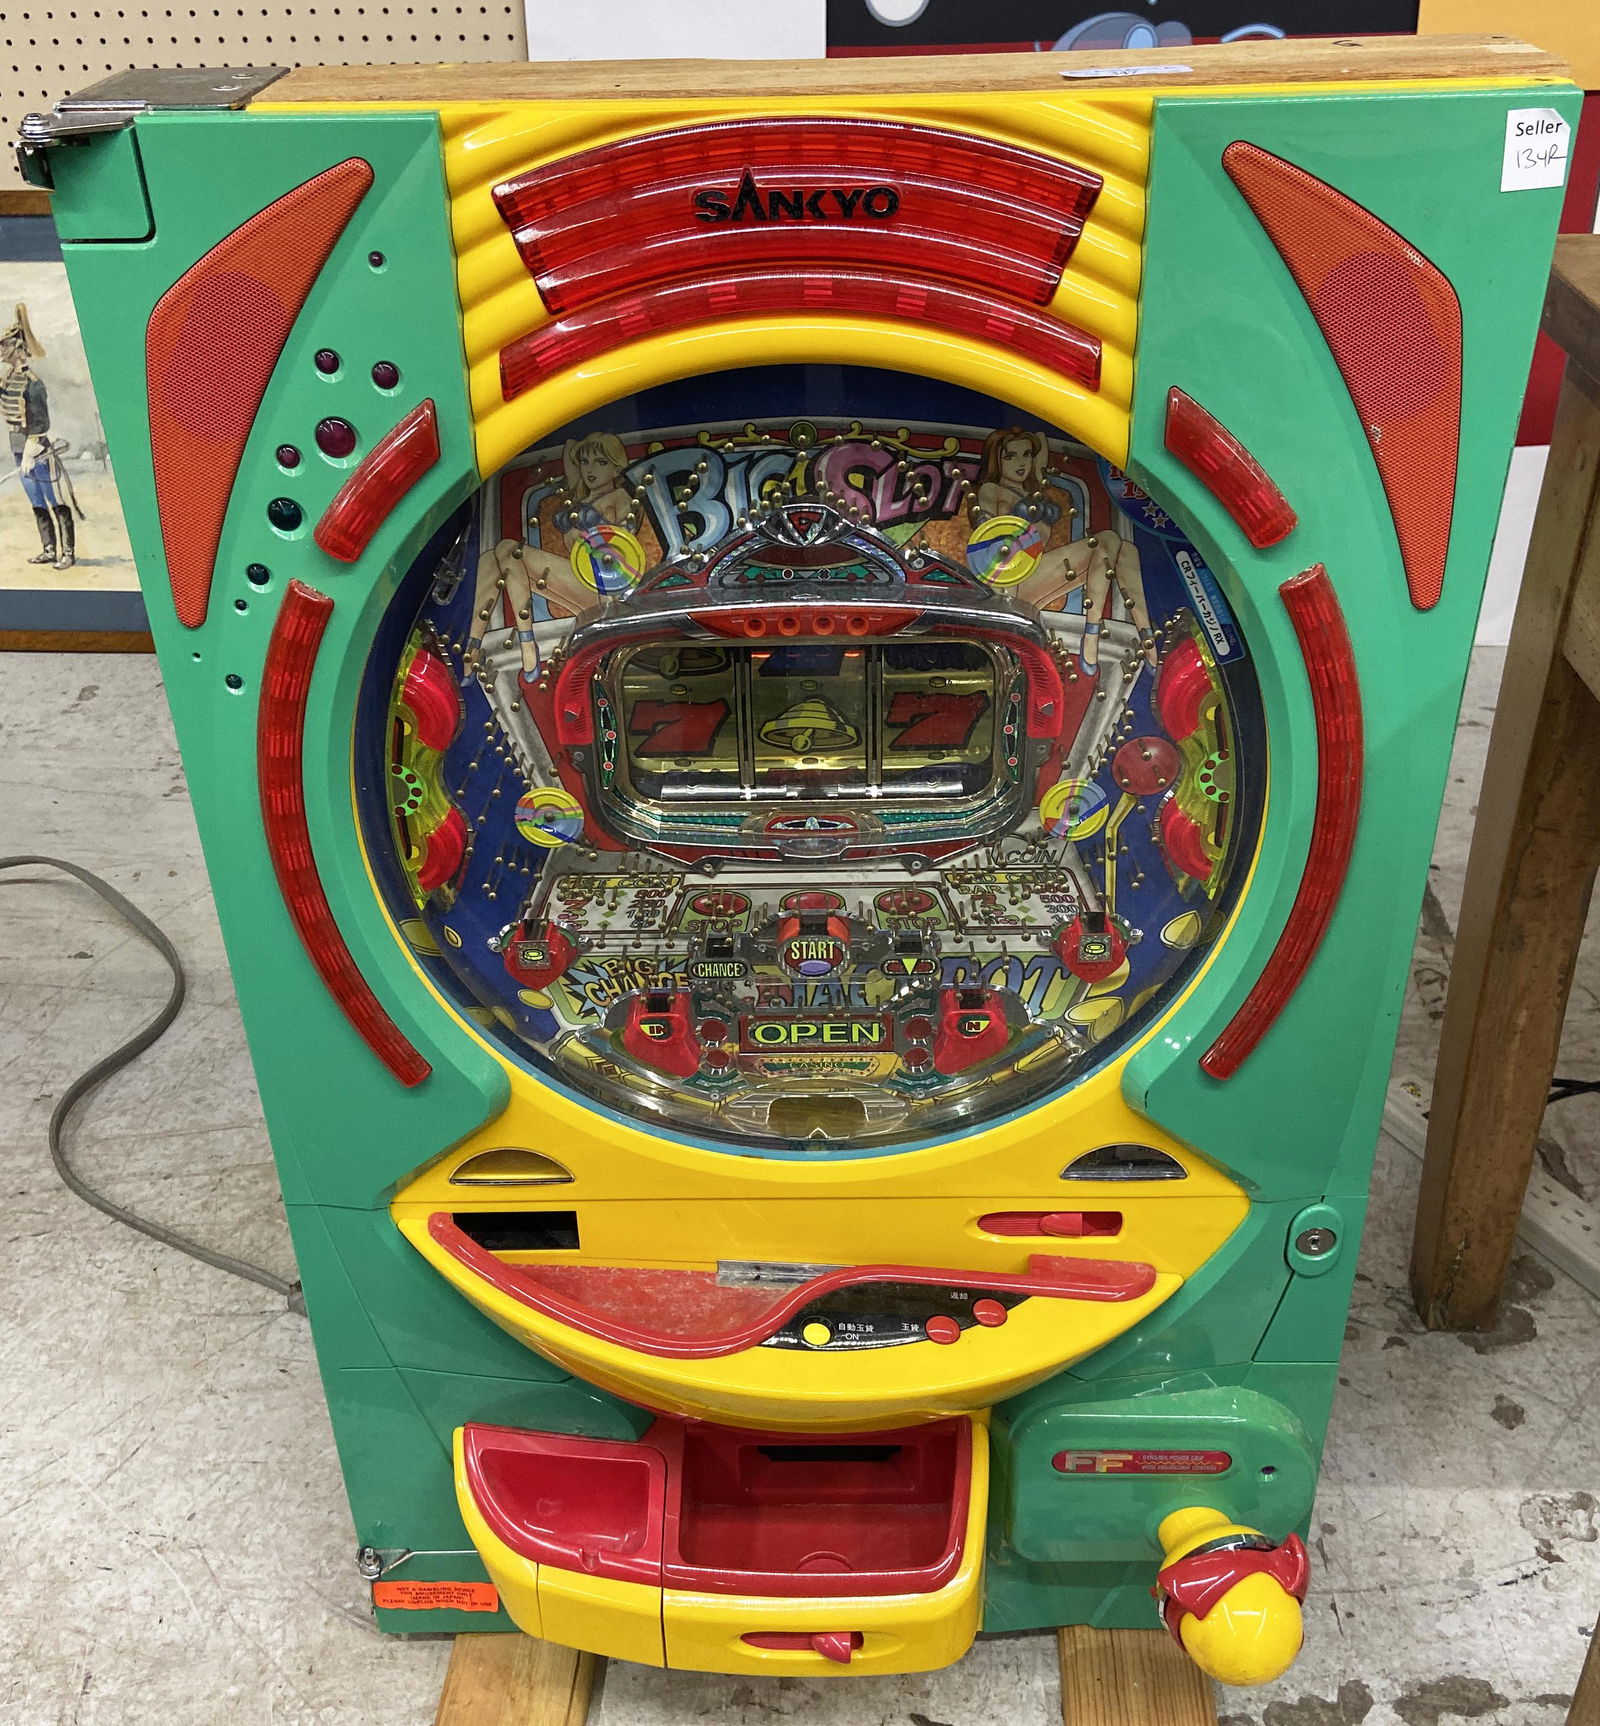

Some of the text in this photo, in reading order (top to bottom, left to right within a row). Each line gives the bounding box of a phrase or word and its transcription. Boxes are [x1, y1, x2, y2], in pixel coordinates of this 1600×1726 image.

[1515, 119, 1563, 137] Seller
[694, 170, 900, 222] SANKYO
[626, 440, 982, 562] BIG SLOT
[628, 698, 732, 758] 7
[885, 690, 990, 752] 7
[1004, 849, 1058, 865] COIN
[956, 884, 1007, 895] BAR
[1039, 894, 1076, 904] 500
[686, 918, 743, 932] STOP
[885, 916, 942, 931] STOP
[790, 941, 836, 960] START
[600, 957, 656, 979] BIG
[697, 962, 742, 978] CHANCE
[754, 1023, 881, 1044] OPEN
[845, 1333, 860, 1341] ON
